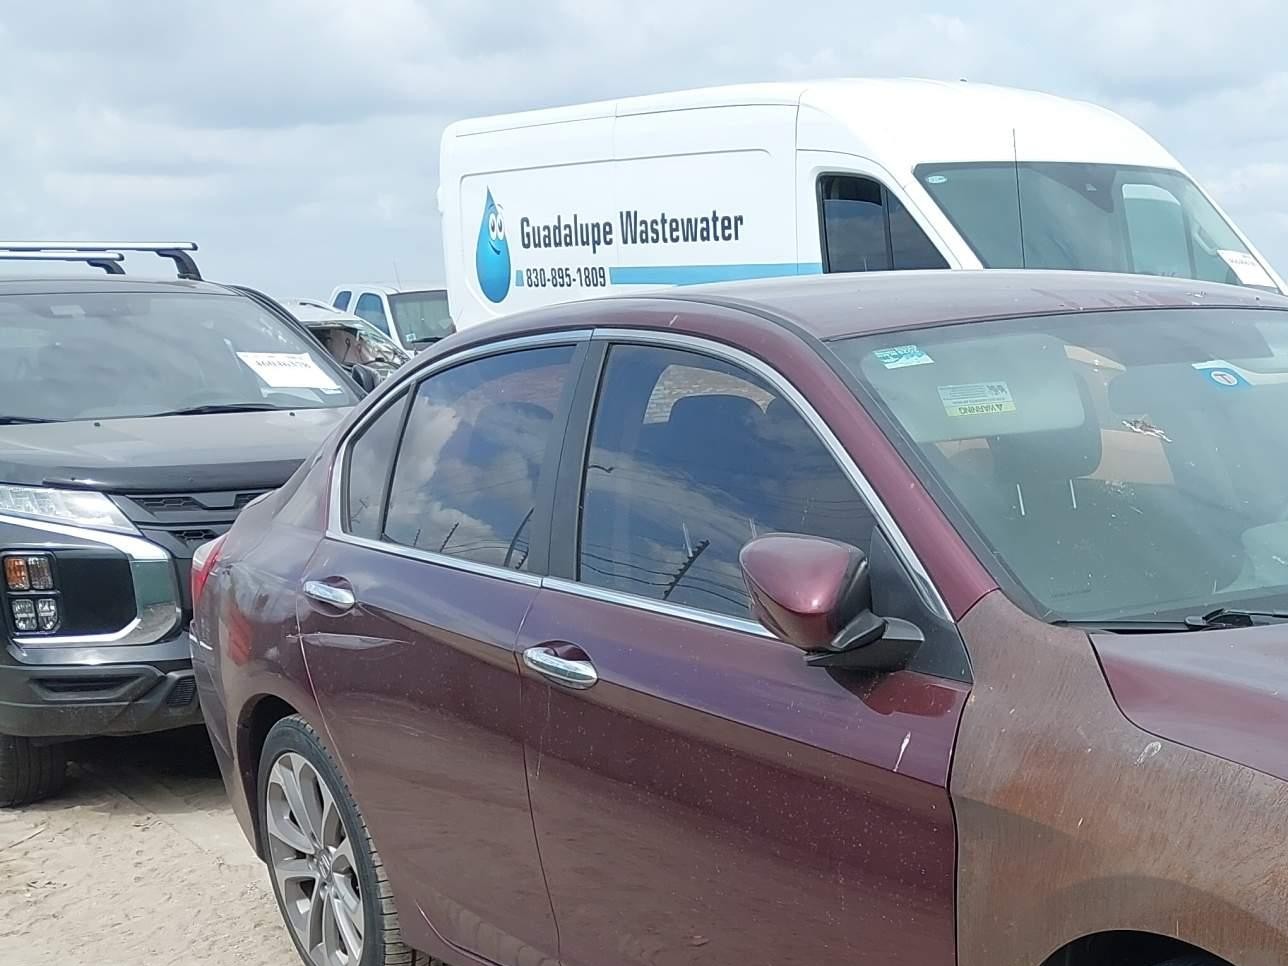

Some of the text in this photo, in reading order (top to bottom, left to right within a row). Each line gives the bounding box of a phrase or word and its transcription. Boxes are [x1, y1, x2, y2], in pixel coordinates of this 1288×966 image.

[521, 211, 743, 253] Guadalupe Wastewater
[527, 267, 605, 287] 830-895-1809
